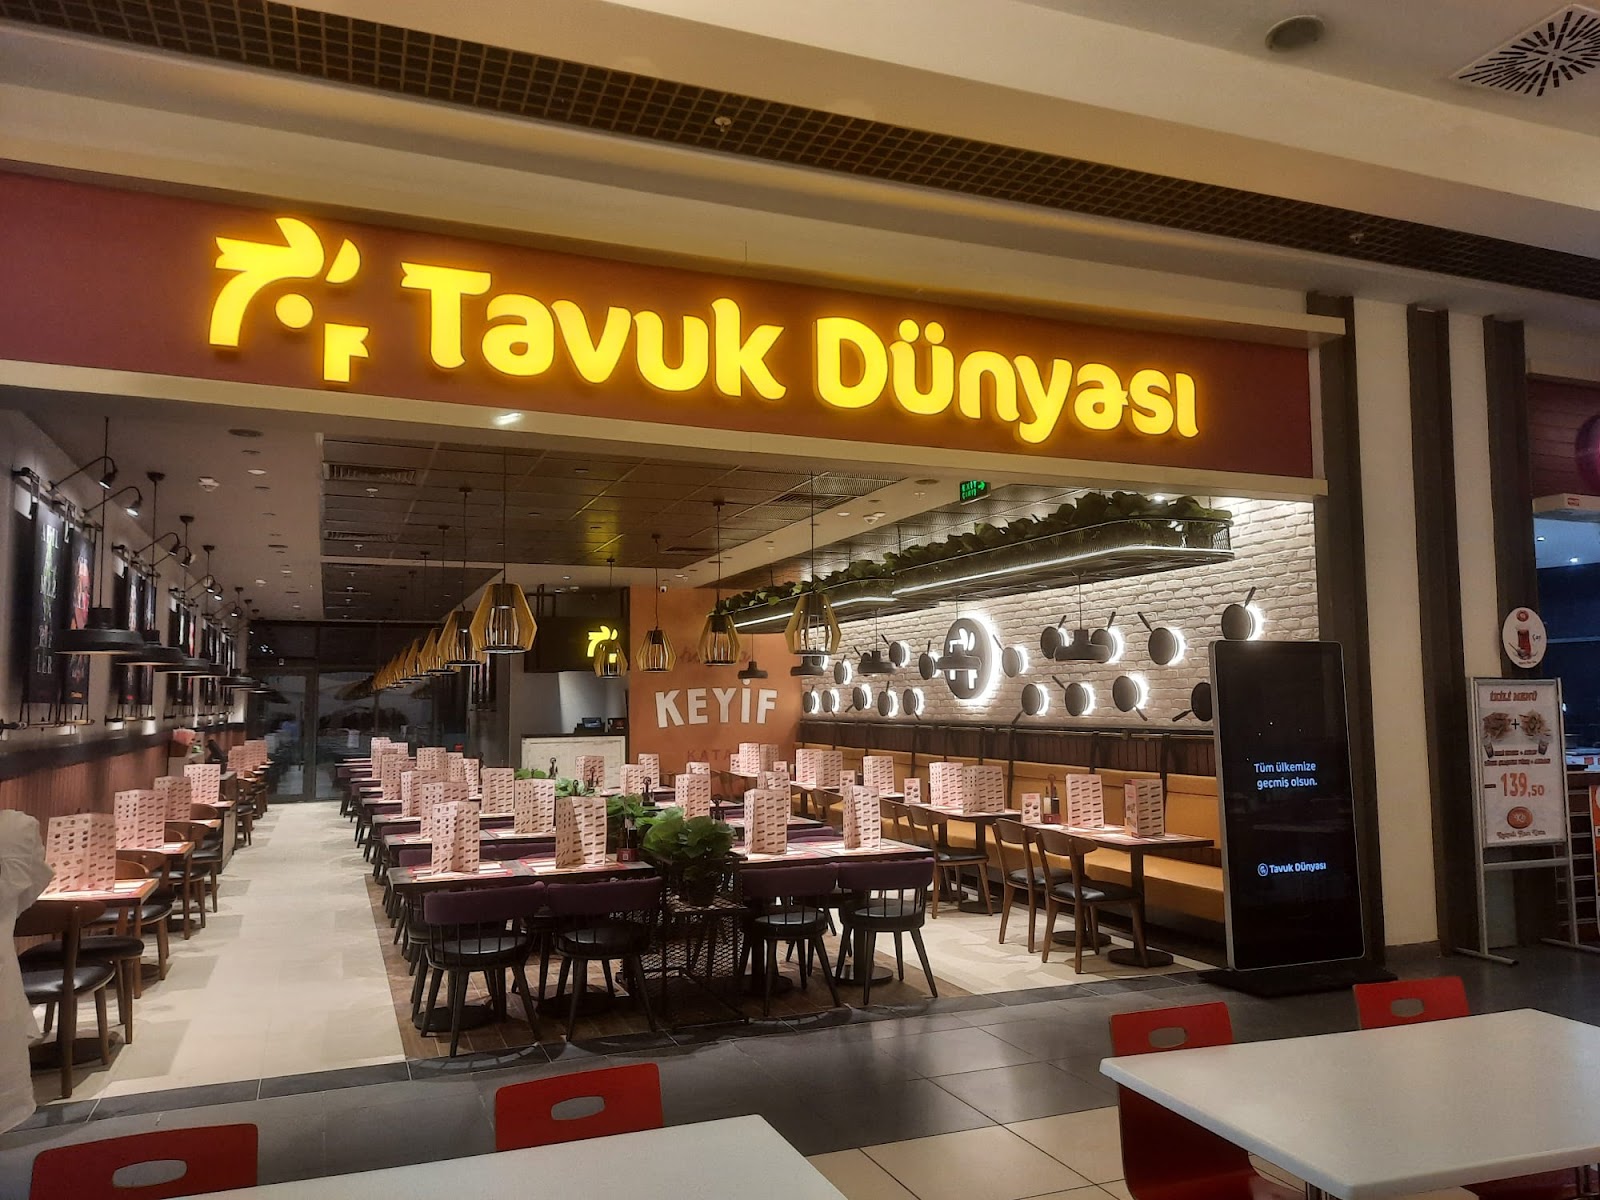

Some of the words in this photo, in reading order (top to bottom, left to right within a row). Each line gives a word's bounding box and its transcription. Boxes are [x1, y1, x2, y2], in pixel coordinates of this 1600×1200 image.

[401, 261, 787, 400] Tavuk
[815, 316, 1200, 444] Dünyası
[655, 678, 778, 728] KEYİF
[1254, 762, 1275, 773] Tüm
[1275, 761, 1316, 772] ülkemize
[1257, 777, 1289, 790] geçmiş
[1269, 863, 1294, 874] Tavuk
[1295, 862, 1326, 873] Dünyası
